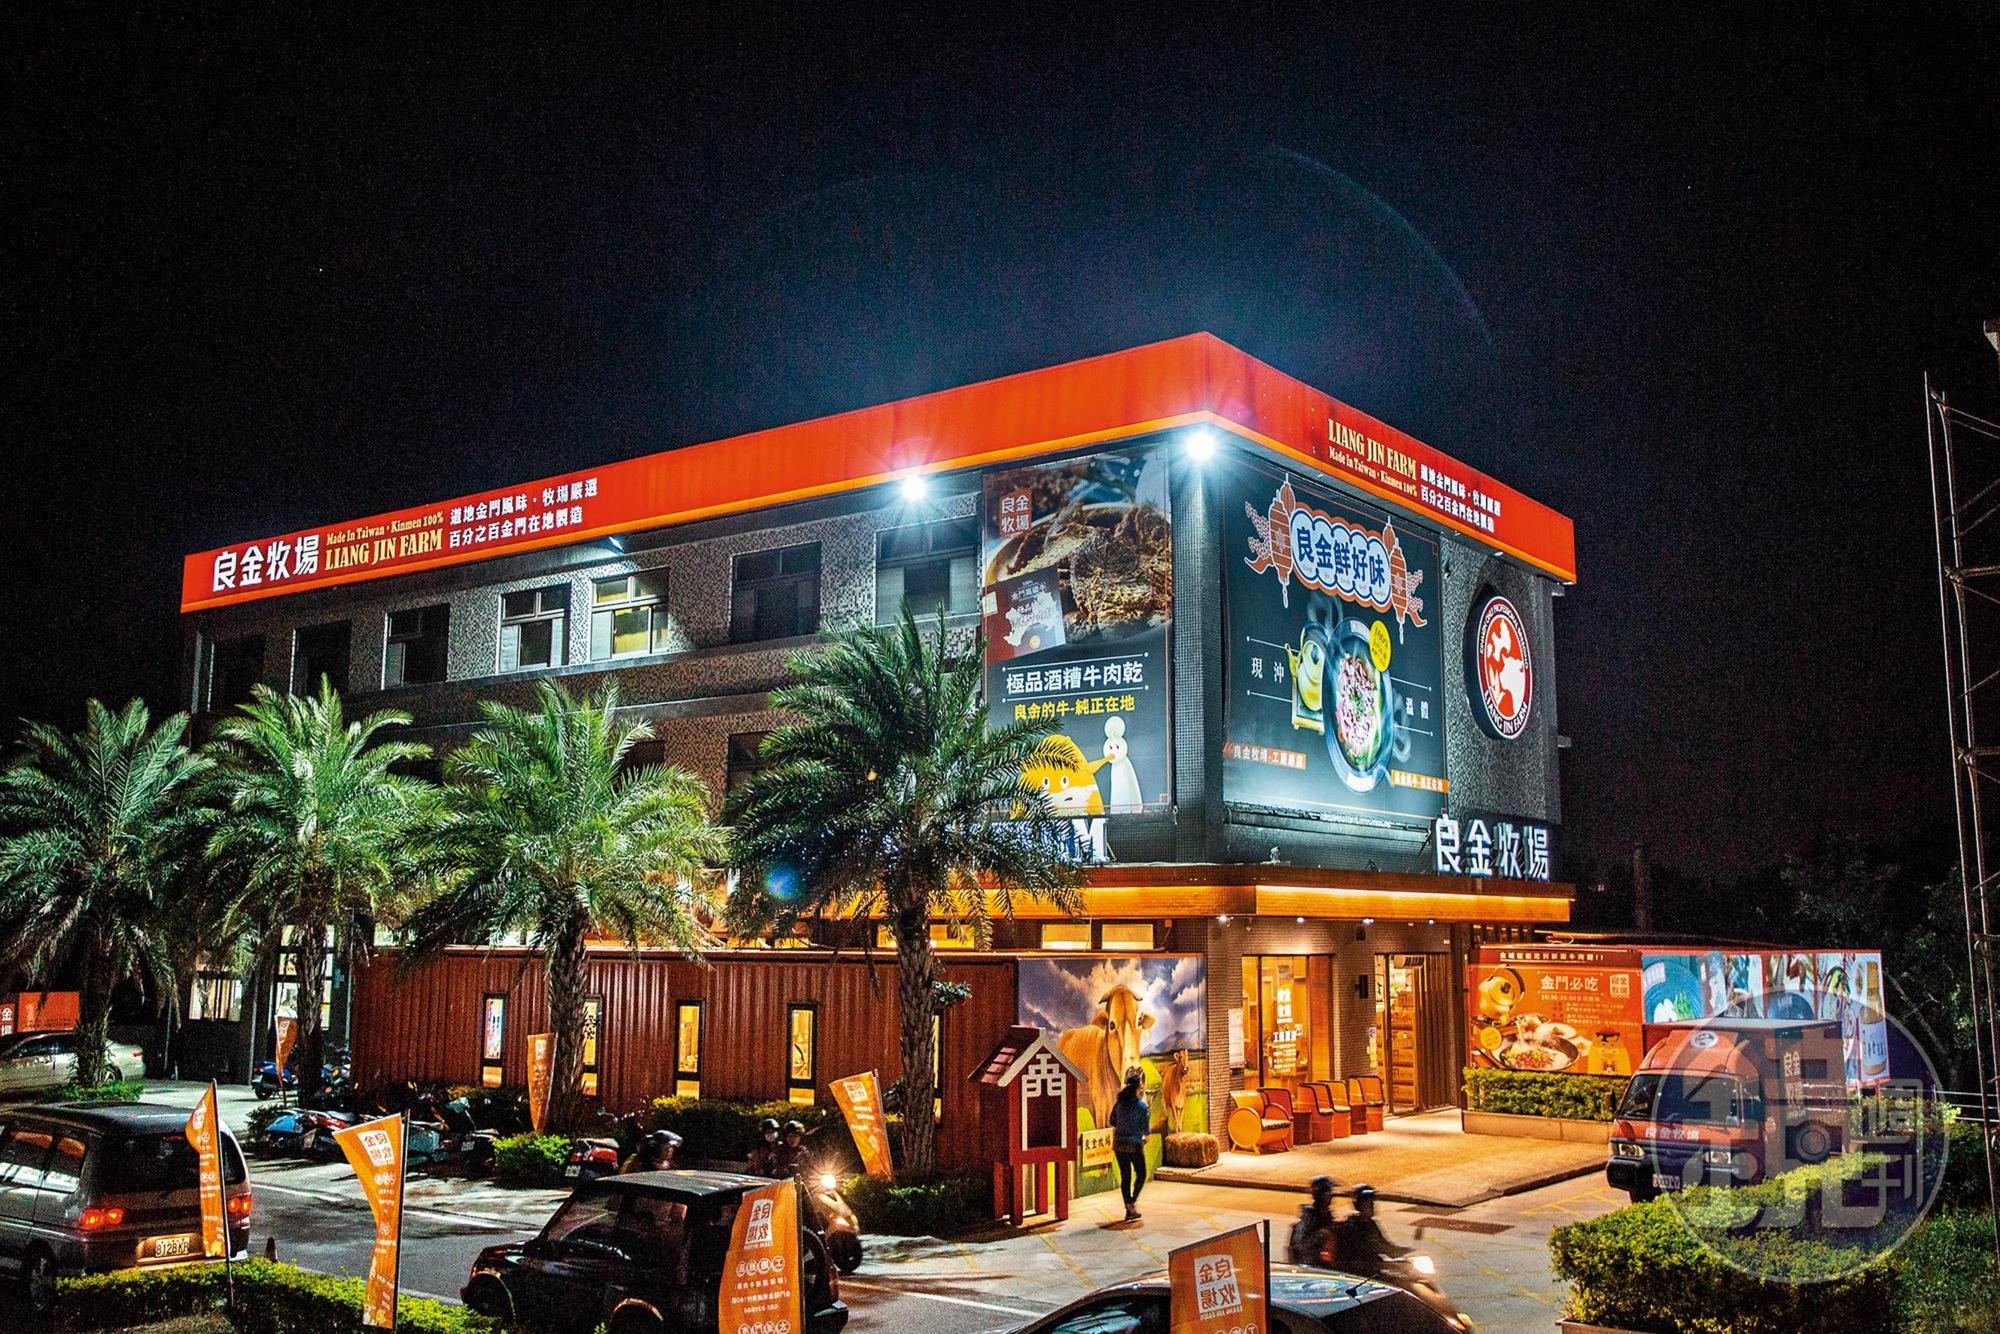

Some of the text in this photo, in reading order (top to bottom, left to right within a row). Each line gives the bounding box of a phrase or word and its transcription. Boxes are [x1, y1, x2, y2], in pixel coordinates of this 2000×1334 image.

[1329, 418, 1417, 480] LIANG JIN FARM
[1329, 446, 1346, 464] Made
[1354, 457, 1377, 479] Taiwan
[1380, 470, 1402, 491] Kinmen
[1001, 494, 1030, 514] 良金
[1001, 514, 1030, 533] 牧場
[327, 511, 444, 545] Made In Taiwan Kinmen 100%
[449, 506, 583, 548] 百分之百金門在地製造
[213, 534, 320, 592] 良金牧場
[325, 528, 443, 570] LIANG JIN FARM
[1297, 526, 1385, 588] 良金鮮好味
[1006, 661, 1143, 694] 極品酒糟牛肉乾
[1485, 690, 1528, 734] LIANG JIN FARM
[1434, 813, 1550, 880] 良金牧場
[1541, 975, 1599, 992] 金門必吃
